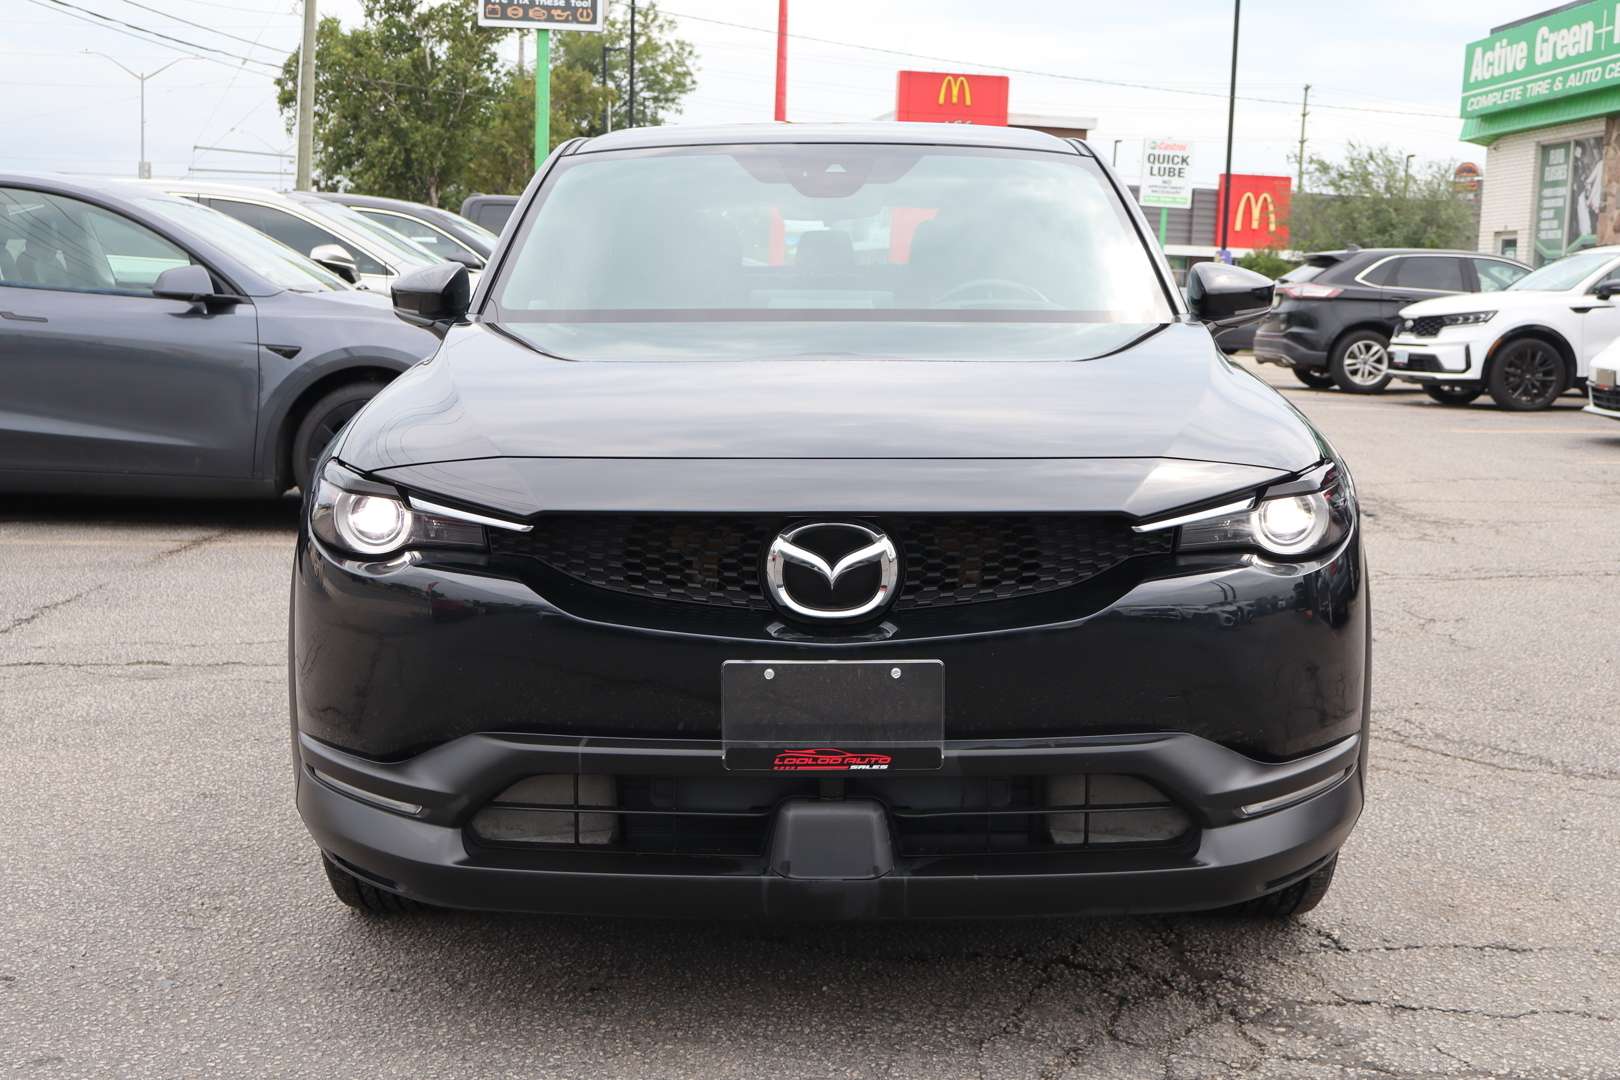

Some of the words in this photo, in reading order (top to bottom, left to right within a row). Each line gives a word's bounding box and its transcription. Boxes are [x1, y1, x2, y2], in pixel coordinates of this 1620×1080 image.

[1470, 38, 1528, 83] Active
[1535, 20, 1594, 65] Green
[1467, 85, 1523, 111] COMPLETE
[1526, 79, 1551, 97] TIRE
[1553, 76, 1563, 91] &
[1565, 67, 1602, 88] AUTO
[1147, 153, 1190, 166] QUICK
[1149, 166, 1185, 178] LUBE
[844, 756, 892, 764] AUTO
